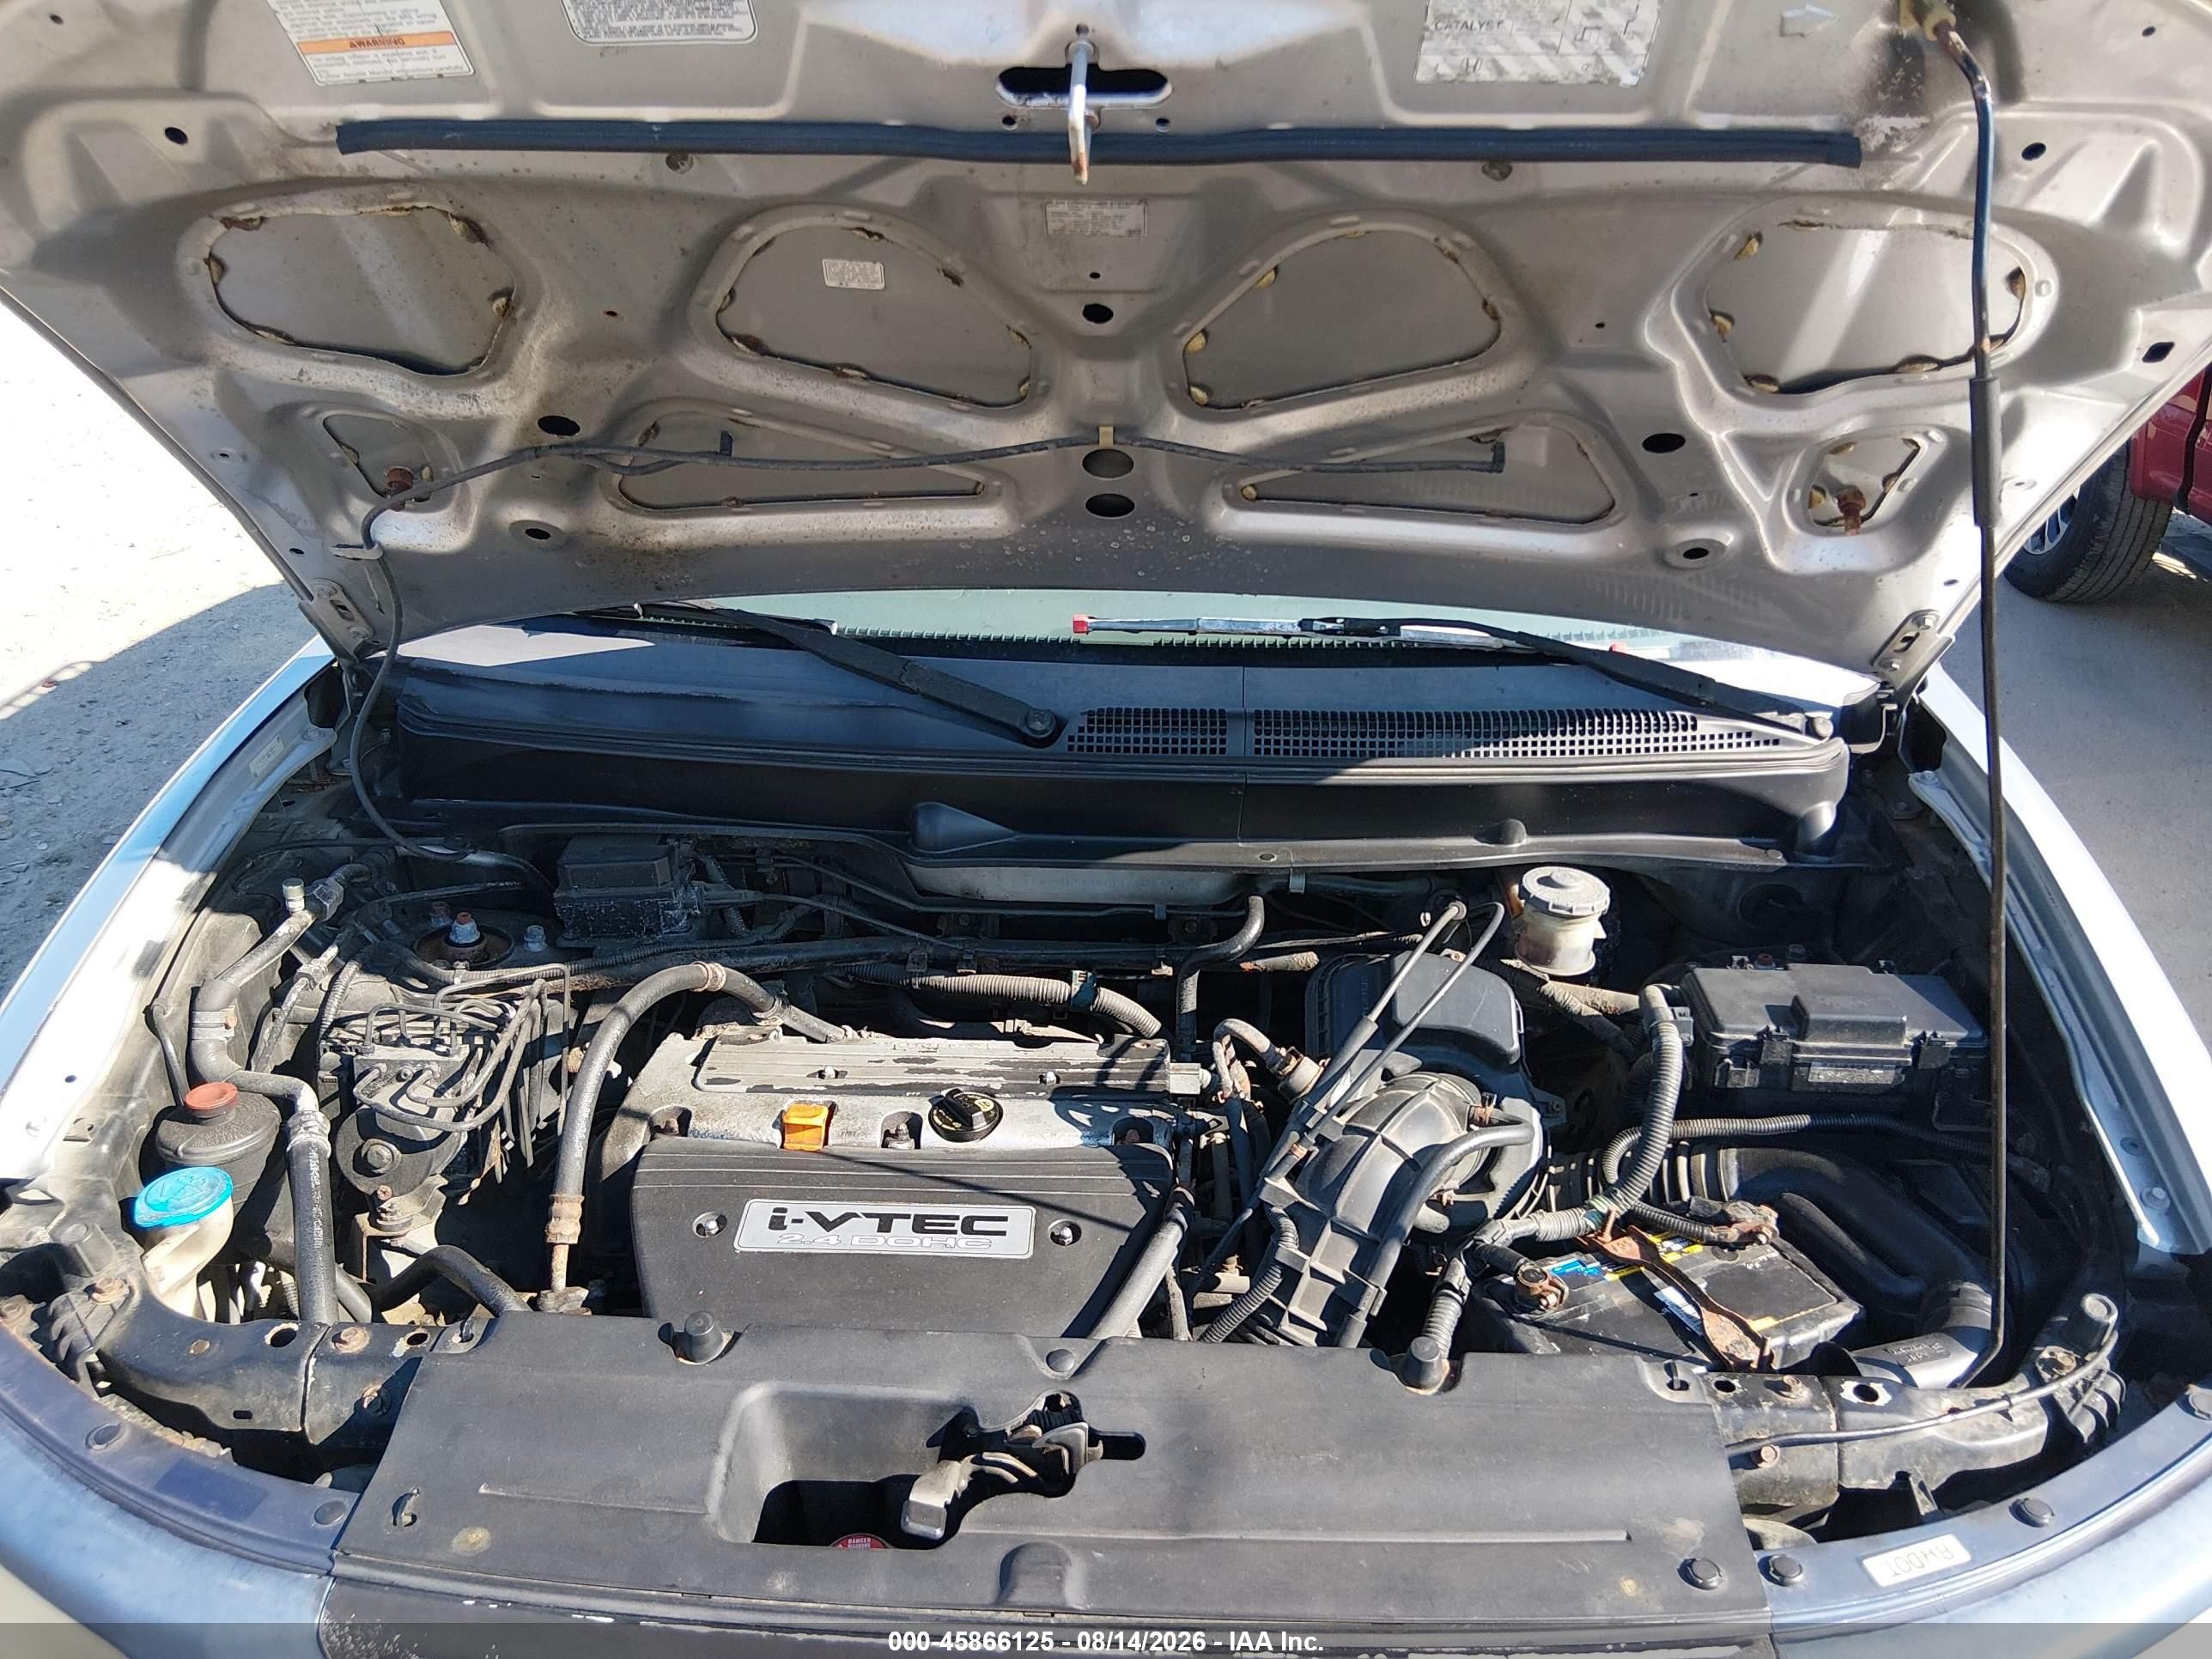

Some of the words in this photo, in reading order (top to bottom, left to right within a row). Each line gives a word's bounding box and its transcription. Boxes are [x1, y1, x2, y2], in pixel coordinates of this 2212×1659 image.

[768, 1206, 1009, 1237] i-VTEC
[777, 1233, 842, 1246] 2.4
[849, 1235, 993, 1249] DOHC
